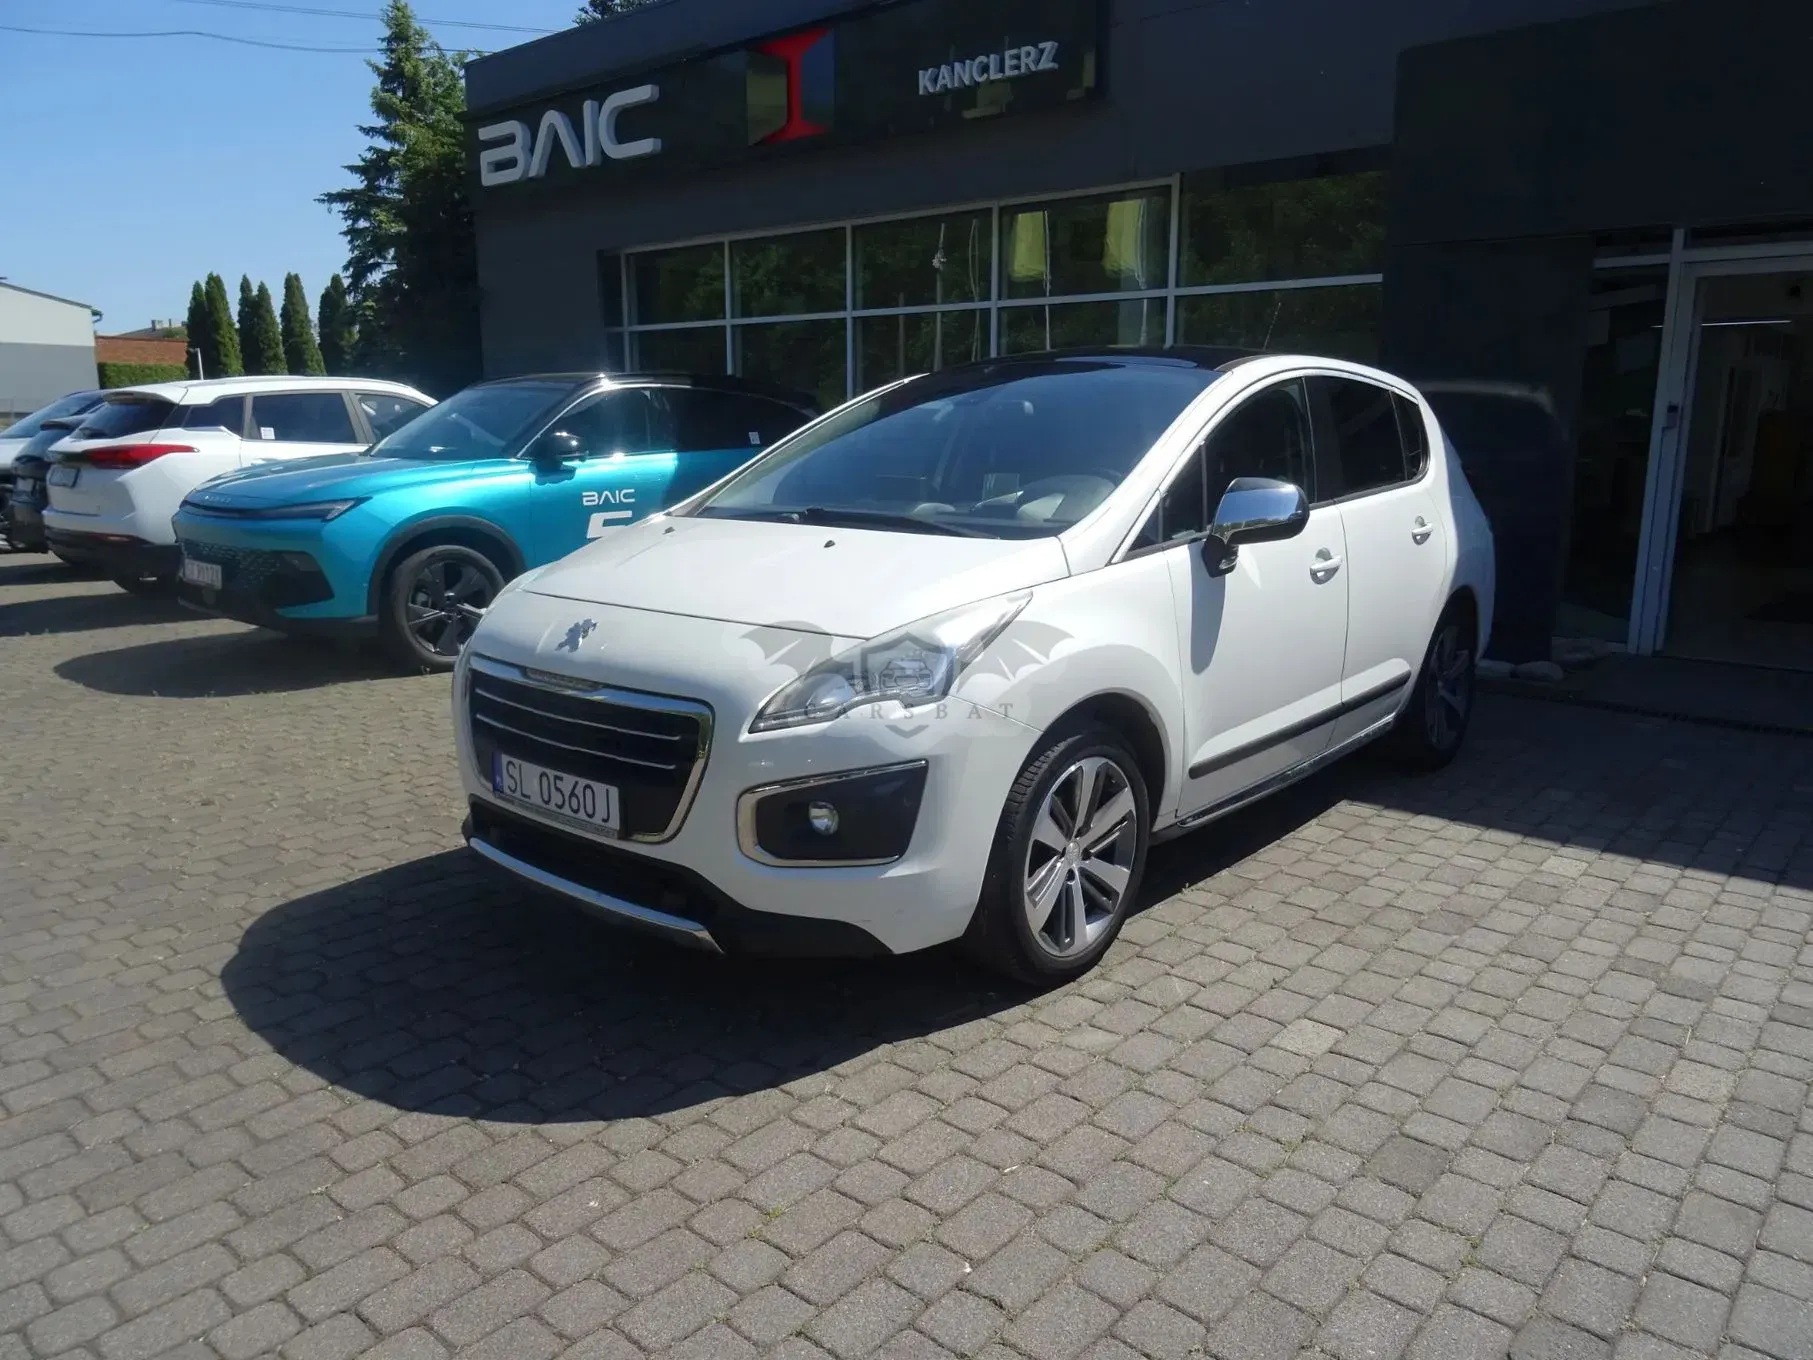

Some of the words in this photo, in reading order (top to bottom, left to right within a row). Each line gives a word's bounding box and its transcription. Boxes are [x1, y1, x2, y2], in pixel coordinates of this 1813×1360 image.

[918, 41, 1058, 95] KANCLERZ
[478, 84, 662, 187] BAIC
[582, 488, 635, 506] BAIC
[506, 760, 531, 799] SL
[539, 770, 611, 823] 0560J
